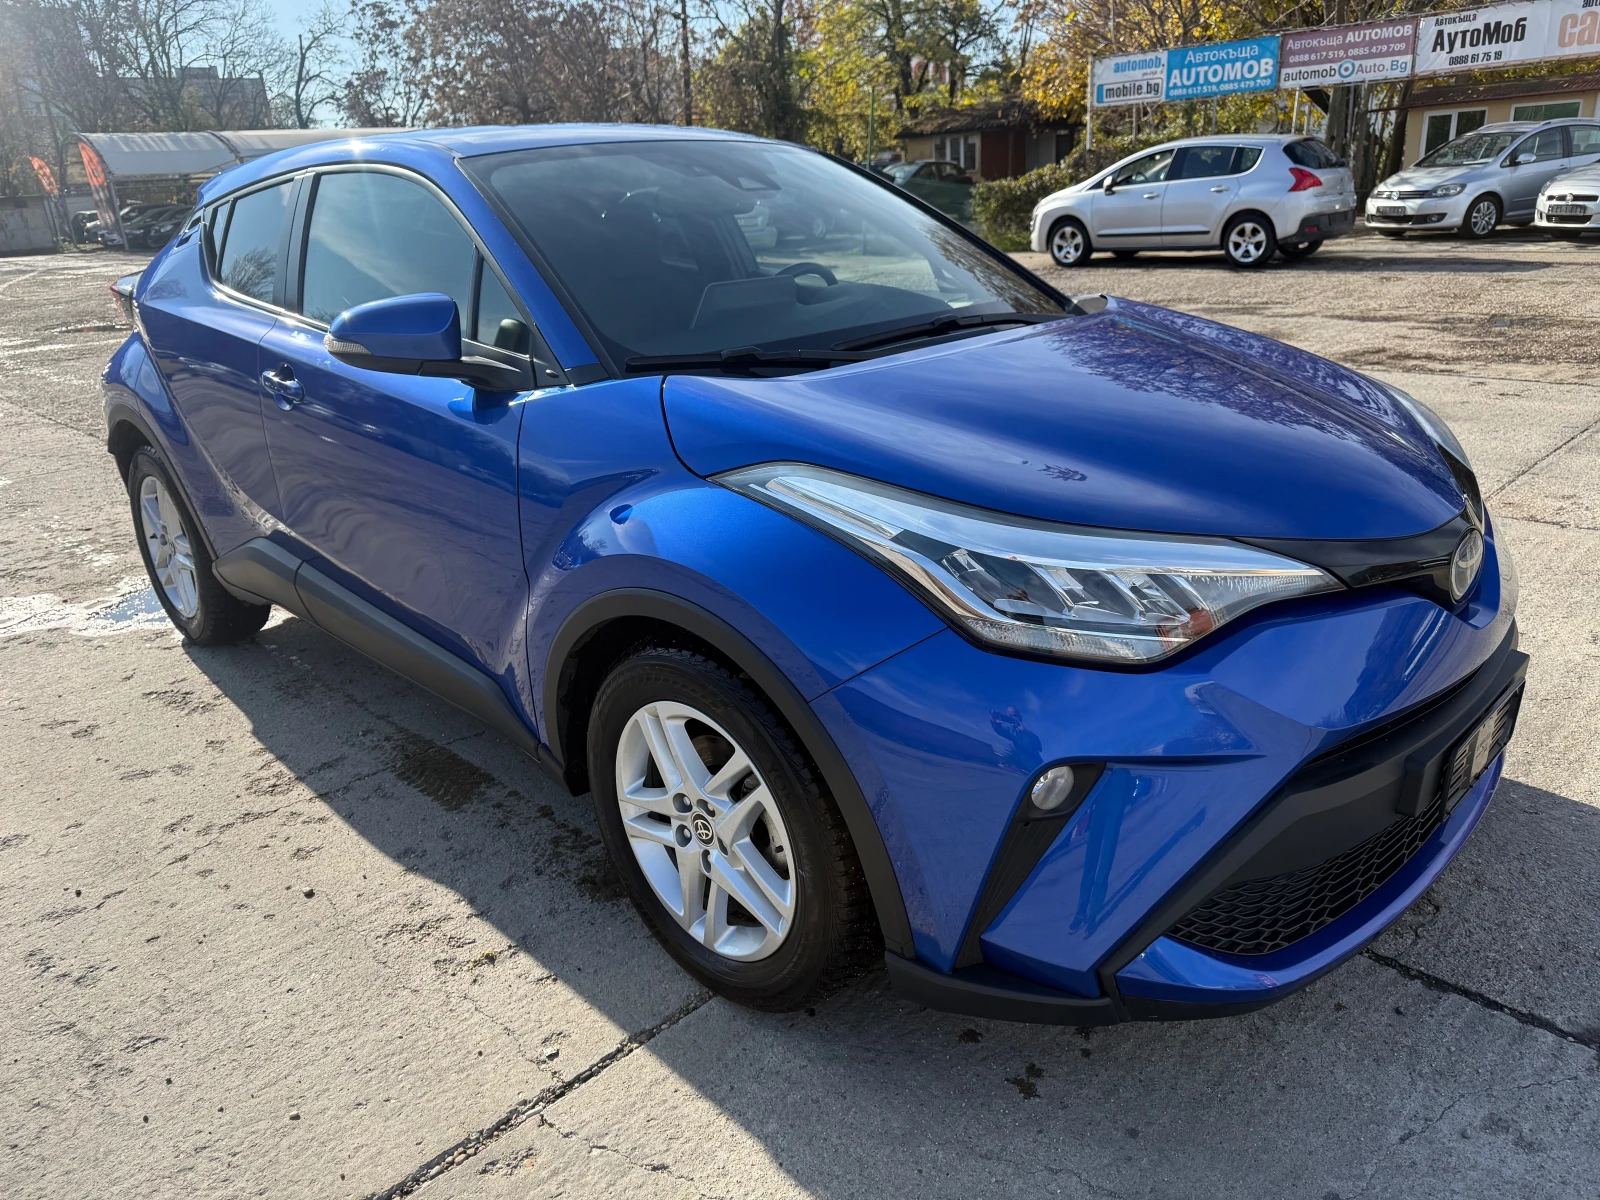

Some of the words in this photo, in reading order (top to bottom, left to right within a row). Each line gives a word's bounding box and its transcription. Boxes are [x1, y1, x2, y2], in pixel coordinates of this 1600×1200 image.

[1434, 13, 1477, 27] Автокъща
[1286, 35, 1343, 50] Автокъща
[1345, 24, 1413, 43] AUTOMOB
[1431, 17, 1527, 54] АутоМоб
[1184, 44, 1259, 65] Автокъща
[1289, 53, 1309, 63] 0888
[1310, 51, 1326, 60] 617
[1328, 50, 1346, 59] 519,
[1348, 47, 1369, 56] 0885
[1371, 45, 1387, 54] 479
[1389, 43, 1406, 52] 709
[1448, 54, 1468, 66] 0888
[1470, 53, 1479, 63] 61
[1481, 52, 1491, 62] 75
[1494, 50, 1503, 61] 19
[1168, 58, 1274, 88] AUTOMOB
[1256, 79, 1271, 87] 709
[1105, 80, 1160, 99] mobile.bg
